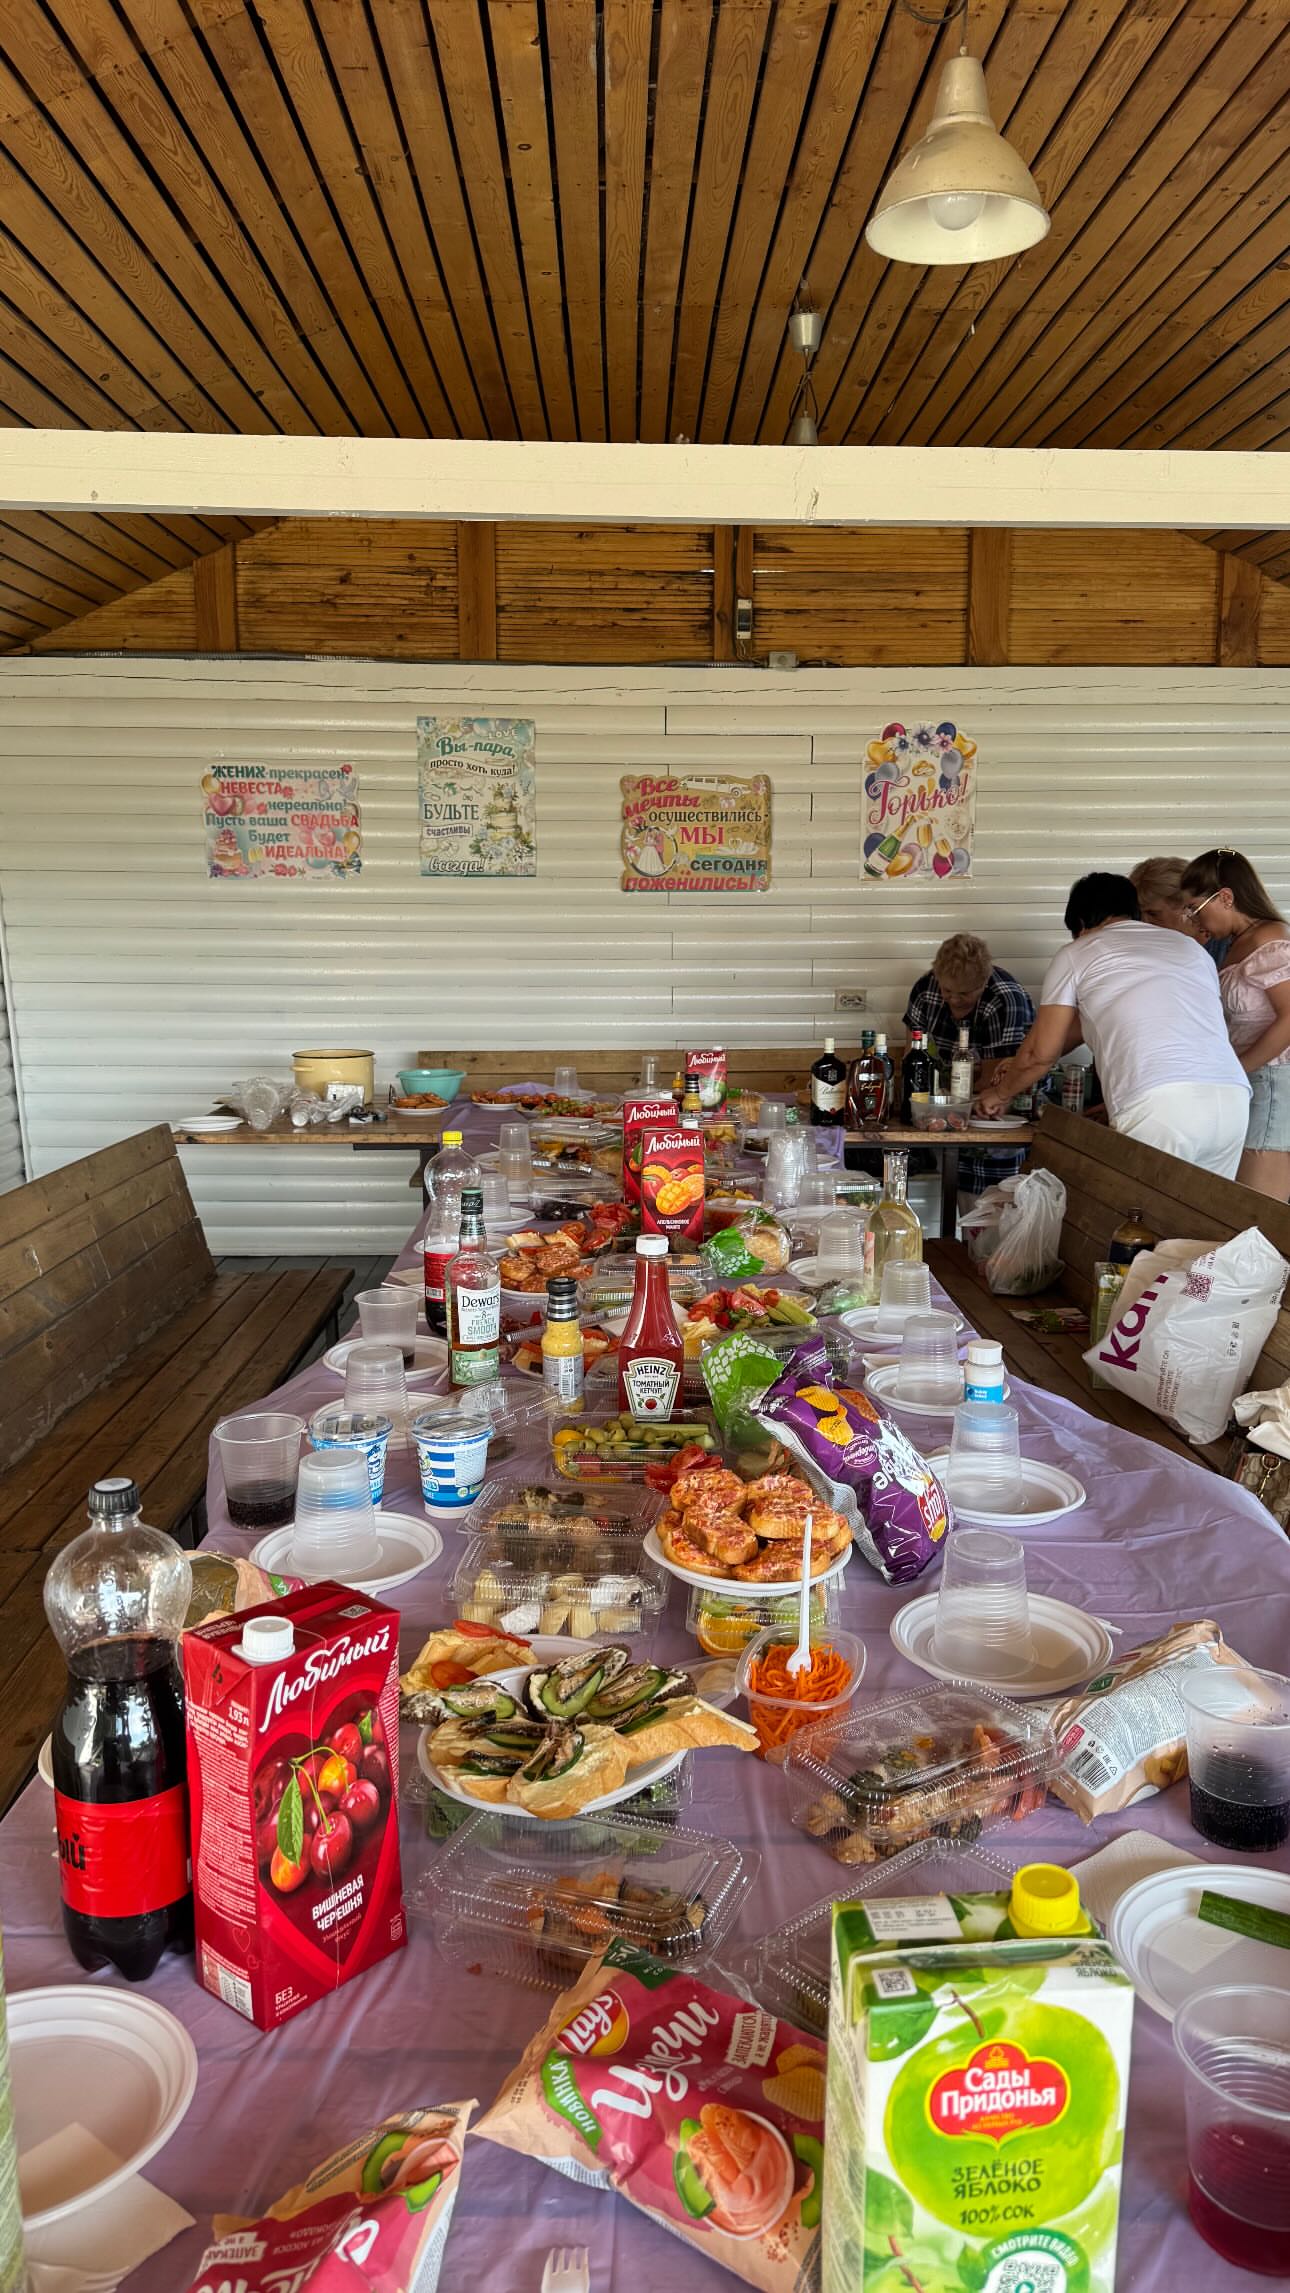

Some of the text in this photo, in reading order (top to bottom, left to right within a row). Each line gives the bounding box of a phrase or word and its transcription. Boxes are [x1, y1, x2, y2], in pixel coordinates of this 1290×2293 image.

[211, 765, 265, 779] ЖЕНИХ
[430, 759, 516, 778] просто хоть куда!
[221, 781, 282, 795] НЕВЕСТА
[637, 777, 680, 797] Все
[268, 799, 347, 813] нереальна!
[623, 794, 701, 819] мечты
[869, 773, 968, 826] Горько!
[206, 813, 359, 829] Пусть ваша СВАДЬБА
[423, 803, 480, 821] БУДЬТЕ
[648, 810, 762, 825] осуществились
[680, 826, 724, 845] МЫ
[264, 845, 348, 861] ИДЕАЛЬНА!
[690, 858, 768, 873] сегодня
[625, 873, 757, 891] поженились!
[688, 1052, 726, 1068] Любимый
[627, 1103, 676, 1123] Любимый
[645, 1133, 700, 1155] Любимый
[637, 1364, 667, 1376] HEINZ
[633, 1379, 670, 1388] ТОМАТНЫЙ
[259, 1624, 390, 1733] Любимый
[312, 1873, 364, 1920] ВИШНЕВАЯ
[316, 1891, 363, 1931] ЧЕРЕШНЯ
[275, 1986, 293, 2004] БЕЗ
[730, 2014, 757, 2065] ЗАПЕКАЮТСЯ
[965, 2067, 1031, 2092] Сады
[549, 2059, 599, 2134] НОВИНКА
[941, 2087, 1057, 2120] Придонья
[951, 2159, 1045, 2183] ЗЕЛЁНОЕ
[953, 2178, 1041, 2199] ЯБЛОКО
[991, 2233, 1080, 2267] СМОТРИТЕ ВИДЕО
